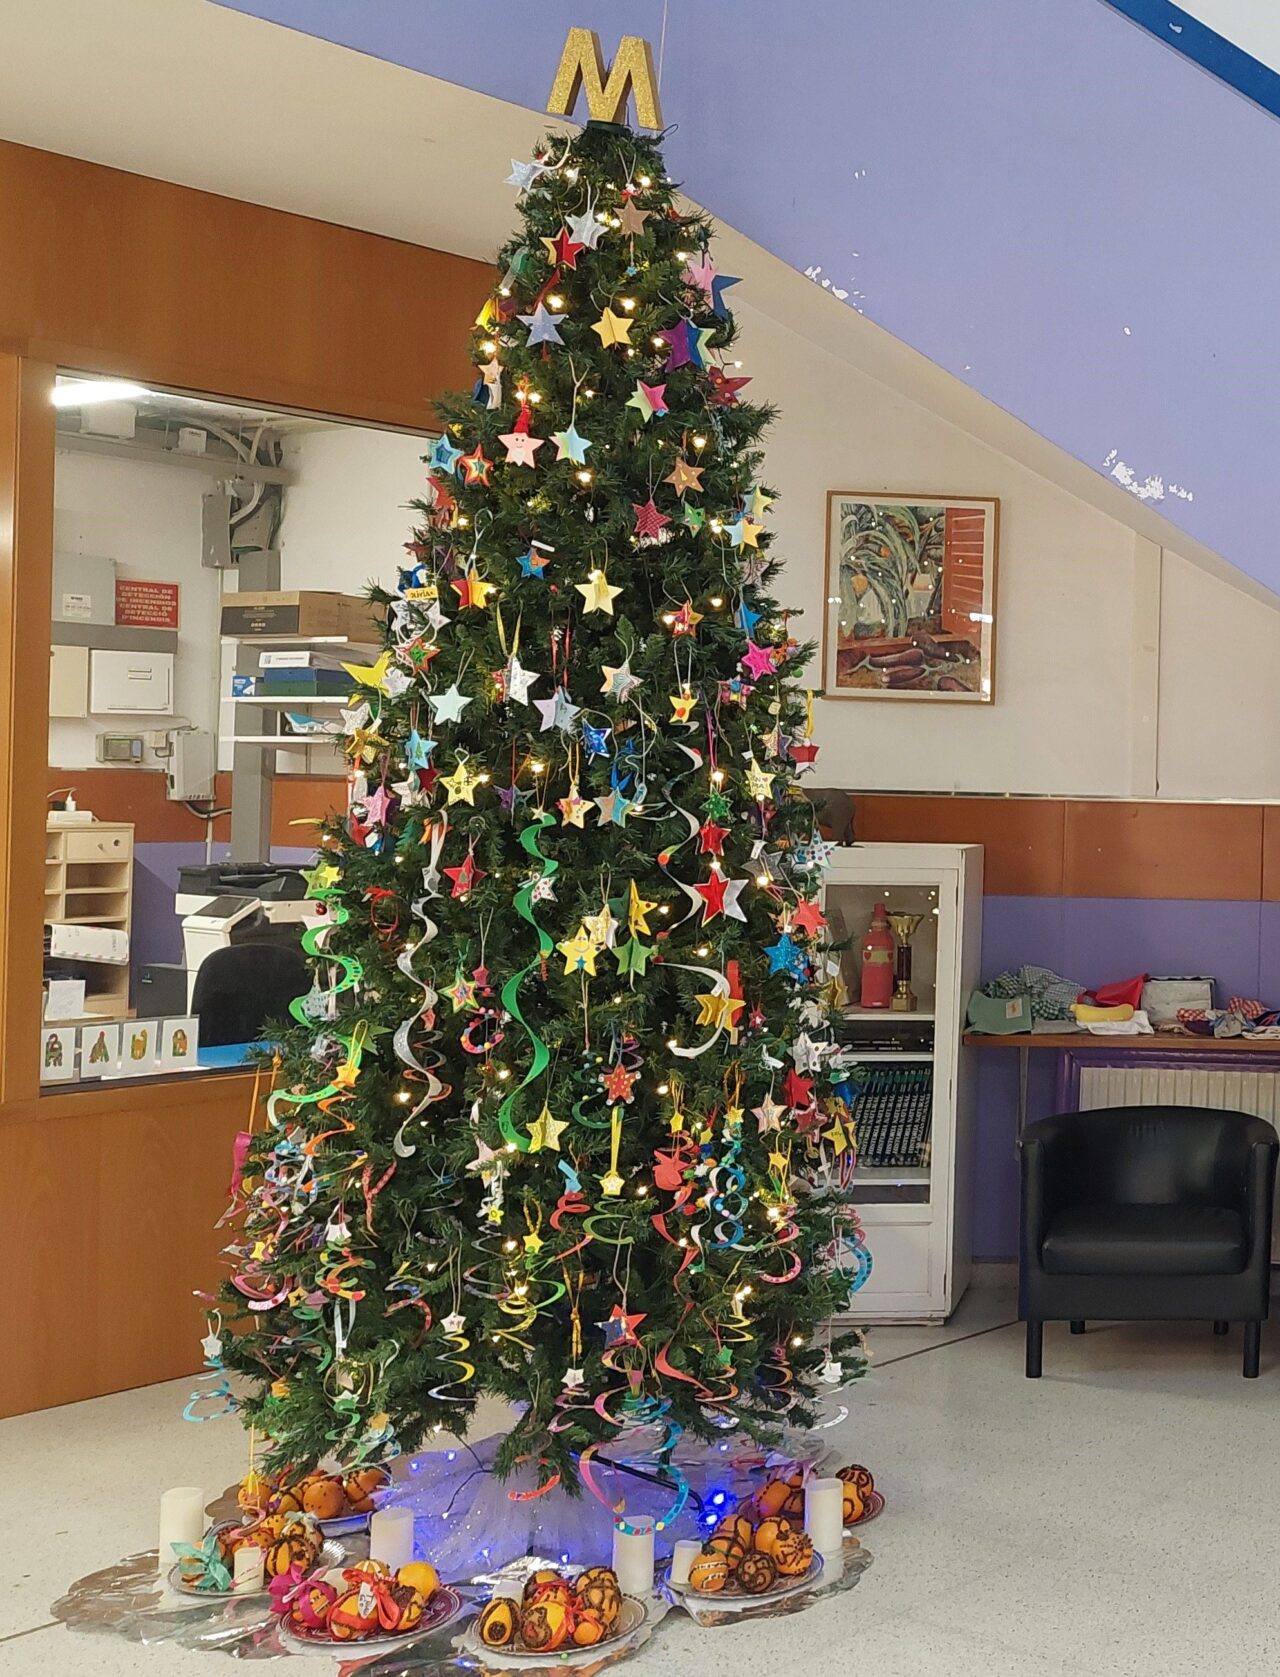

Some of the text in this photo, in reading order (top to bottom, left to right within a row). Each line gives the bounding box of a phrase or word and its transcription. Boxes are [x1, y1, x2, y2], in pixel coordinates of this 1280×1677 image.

[546, 26, 663, 131] M
[119, 585, 159, 593] CENTRAL
[129, 598, 176, 606] INCENDIOS
[119, 603, 159, 611] CENTRAL
